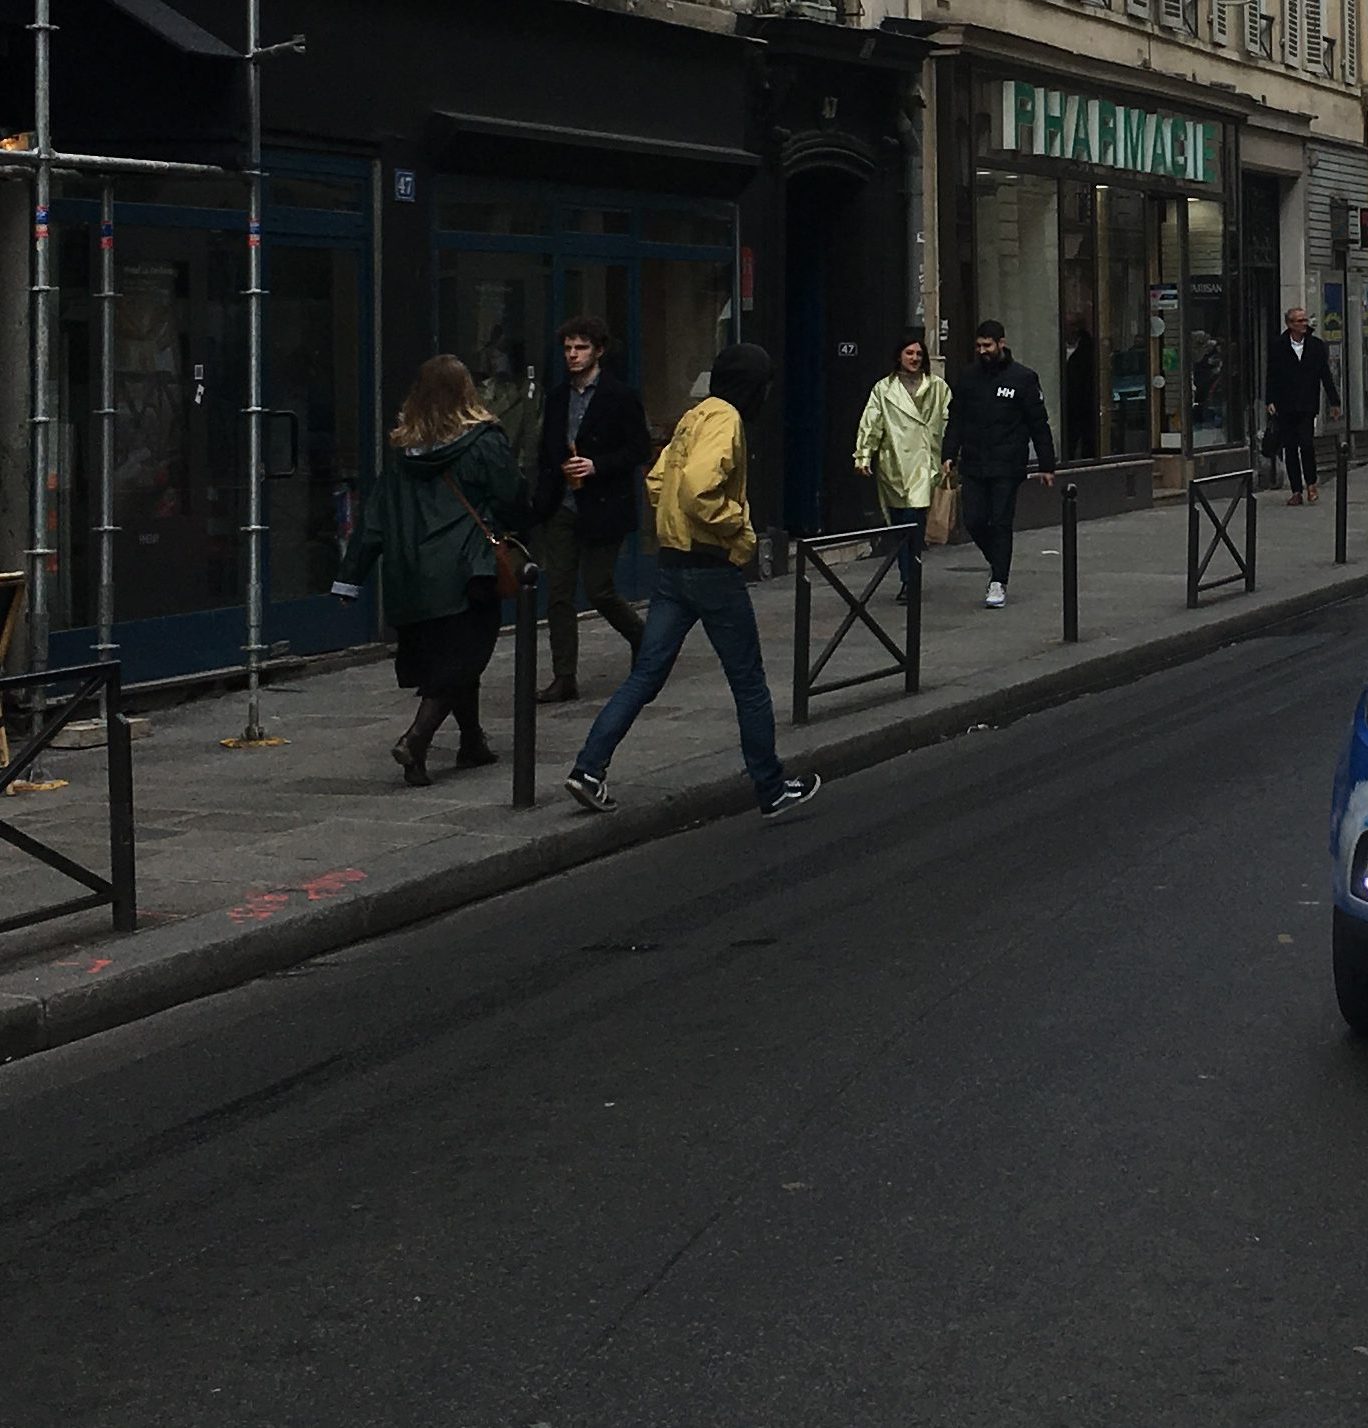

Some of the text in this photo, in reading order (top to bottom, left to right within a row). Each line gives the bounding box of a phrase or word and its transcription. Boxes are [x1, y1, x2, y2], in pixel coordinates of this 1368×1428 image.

[1003, 80, 1217, 183] PHARMACIE
[398, 176, 413, 195] 47
[841, 344, 855, 355] 47
[996, 386, 1015, 399] HH
